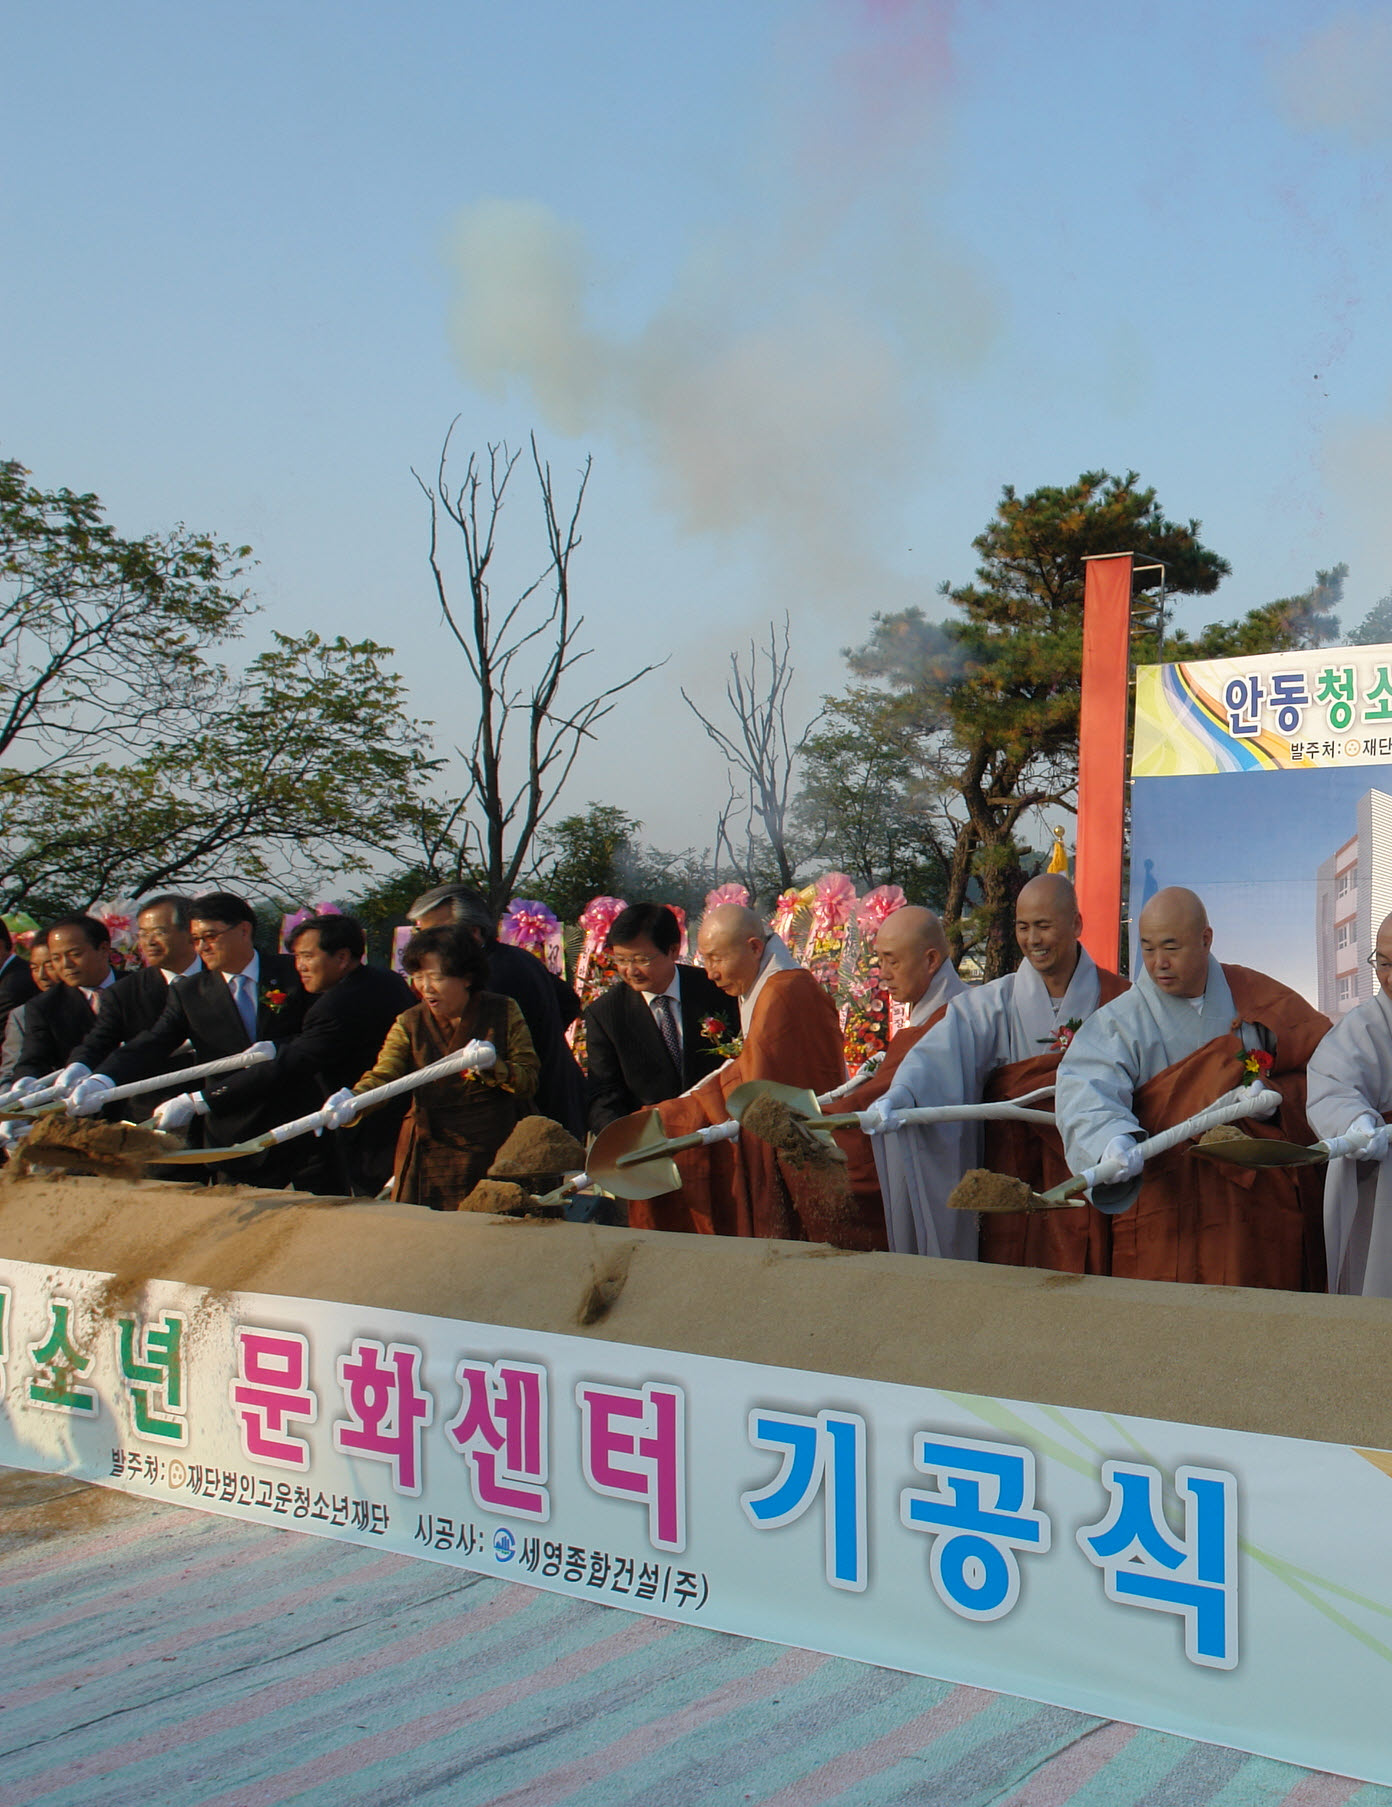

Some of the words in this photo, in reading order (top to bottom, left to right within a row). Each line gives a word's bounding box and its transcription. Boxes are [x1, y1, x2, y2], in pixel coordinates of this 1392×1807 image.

[1226, 674, 1308, 734] 안동
[1290, 740, 1341, 760] 발주처:
[0, 1293, 183, 1440] 소년
[234, 1333, 677, 1543] 문화센터
[748, 1418, 1226, 1659] 기공식
[109, 1448, 165, 1485] 발주처:
[186, 1464, 390, 1535] 재단법인고운청소년재단
[414, 1514, 484, 1556] 시공사:
[518, 1537, 710, 1611] 세영종합건설(주)
